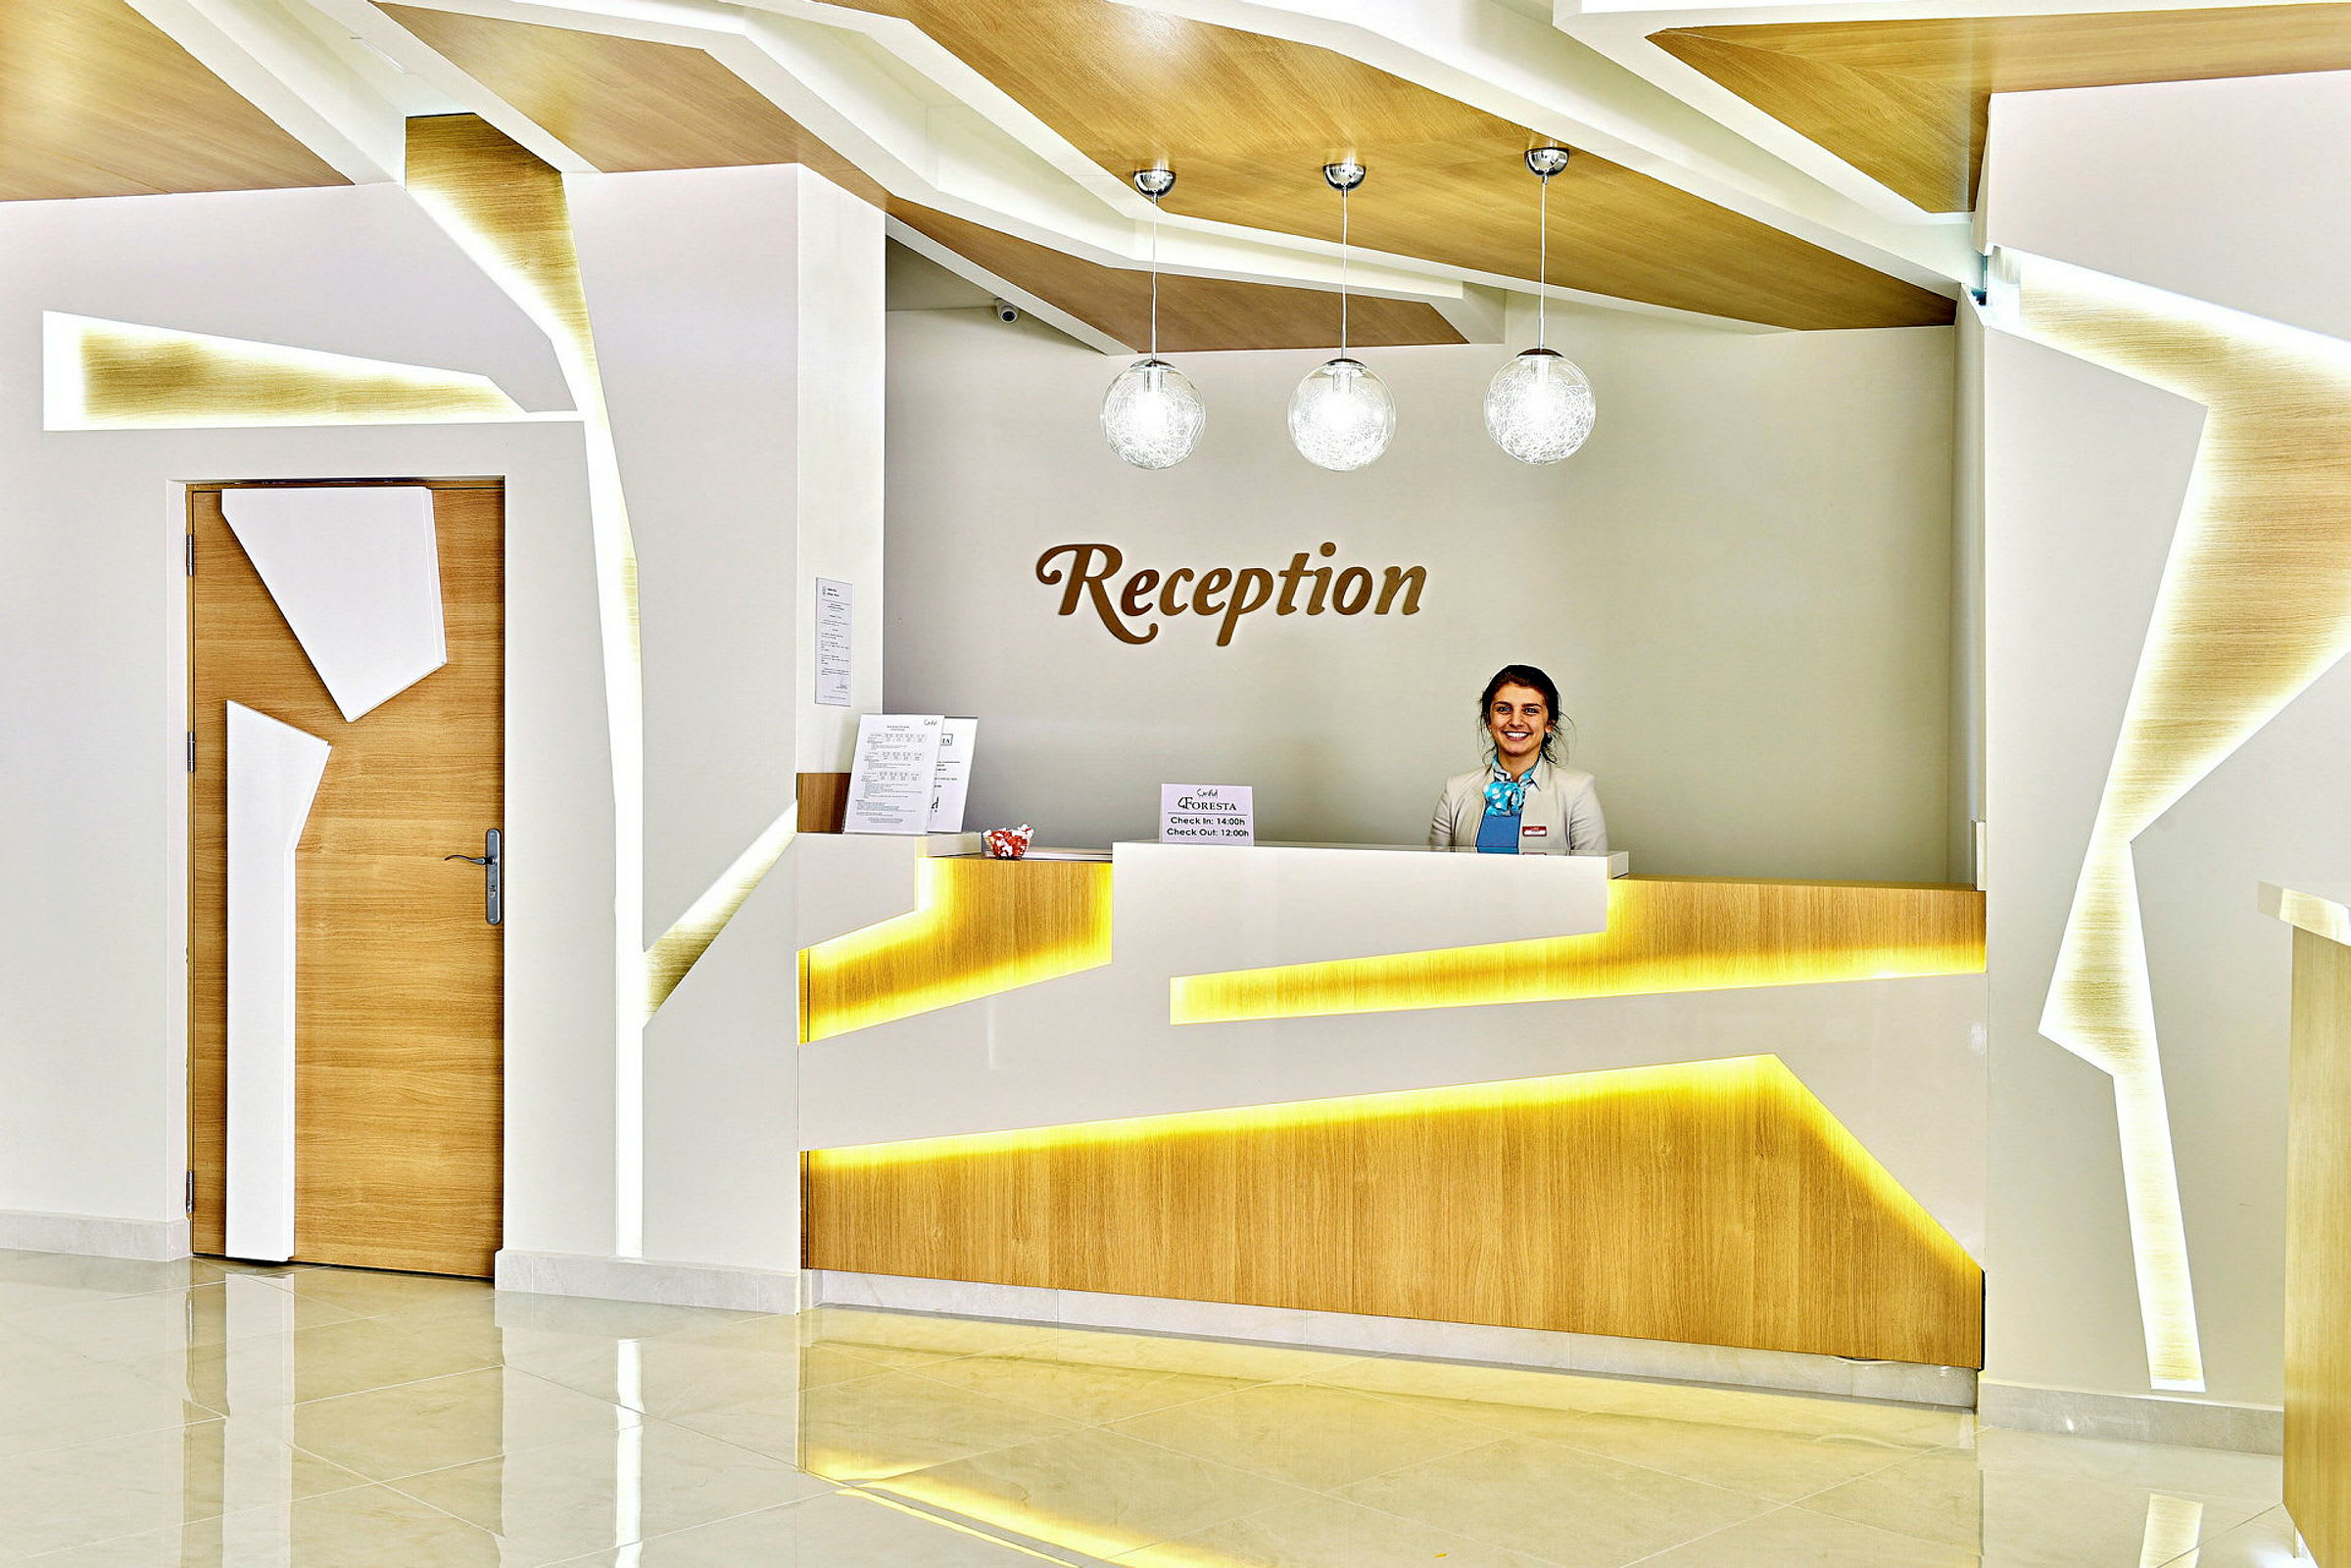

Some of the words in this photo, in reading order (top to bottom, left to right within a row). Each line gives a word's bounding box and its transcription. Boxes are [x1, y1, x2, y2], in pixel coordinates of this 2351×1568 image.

[1035, 542, 1427, 646] Reception
[1177, 796, 1237, 811] FORESTA
[1171, 816, 1201, 825] Check
[1217, 817, 1245, 826] 14:00h
[1221, 829, 1249, 837] 12:00h
